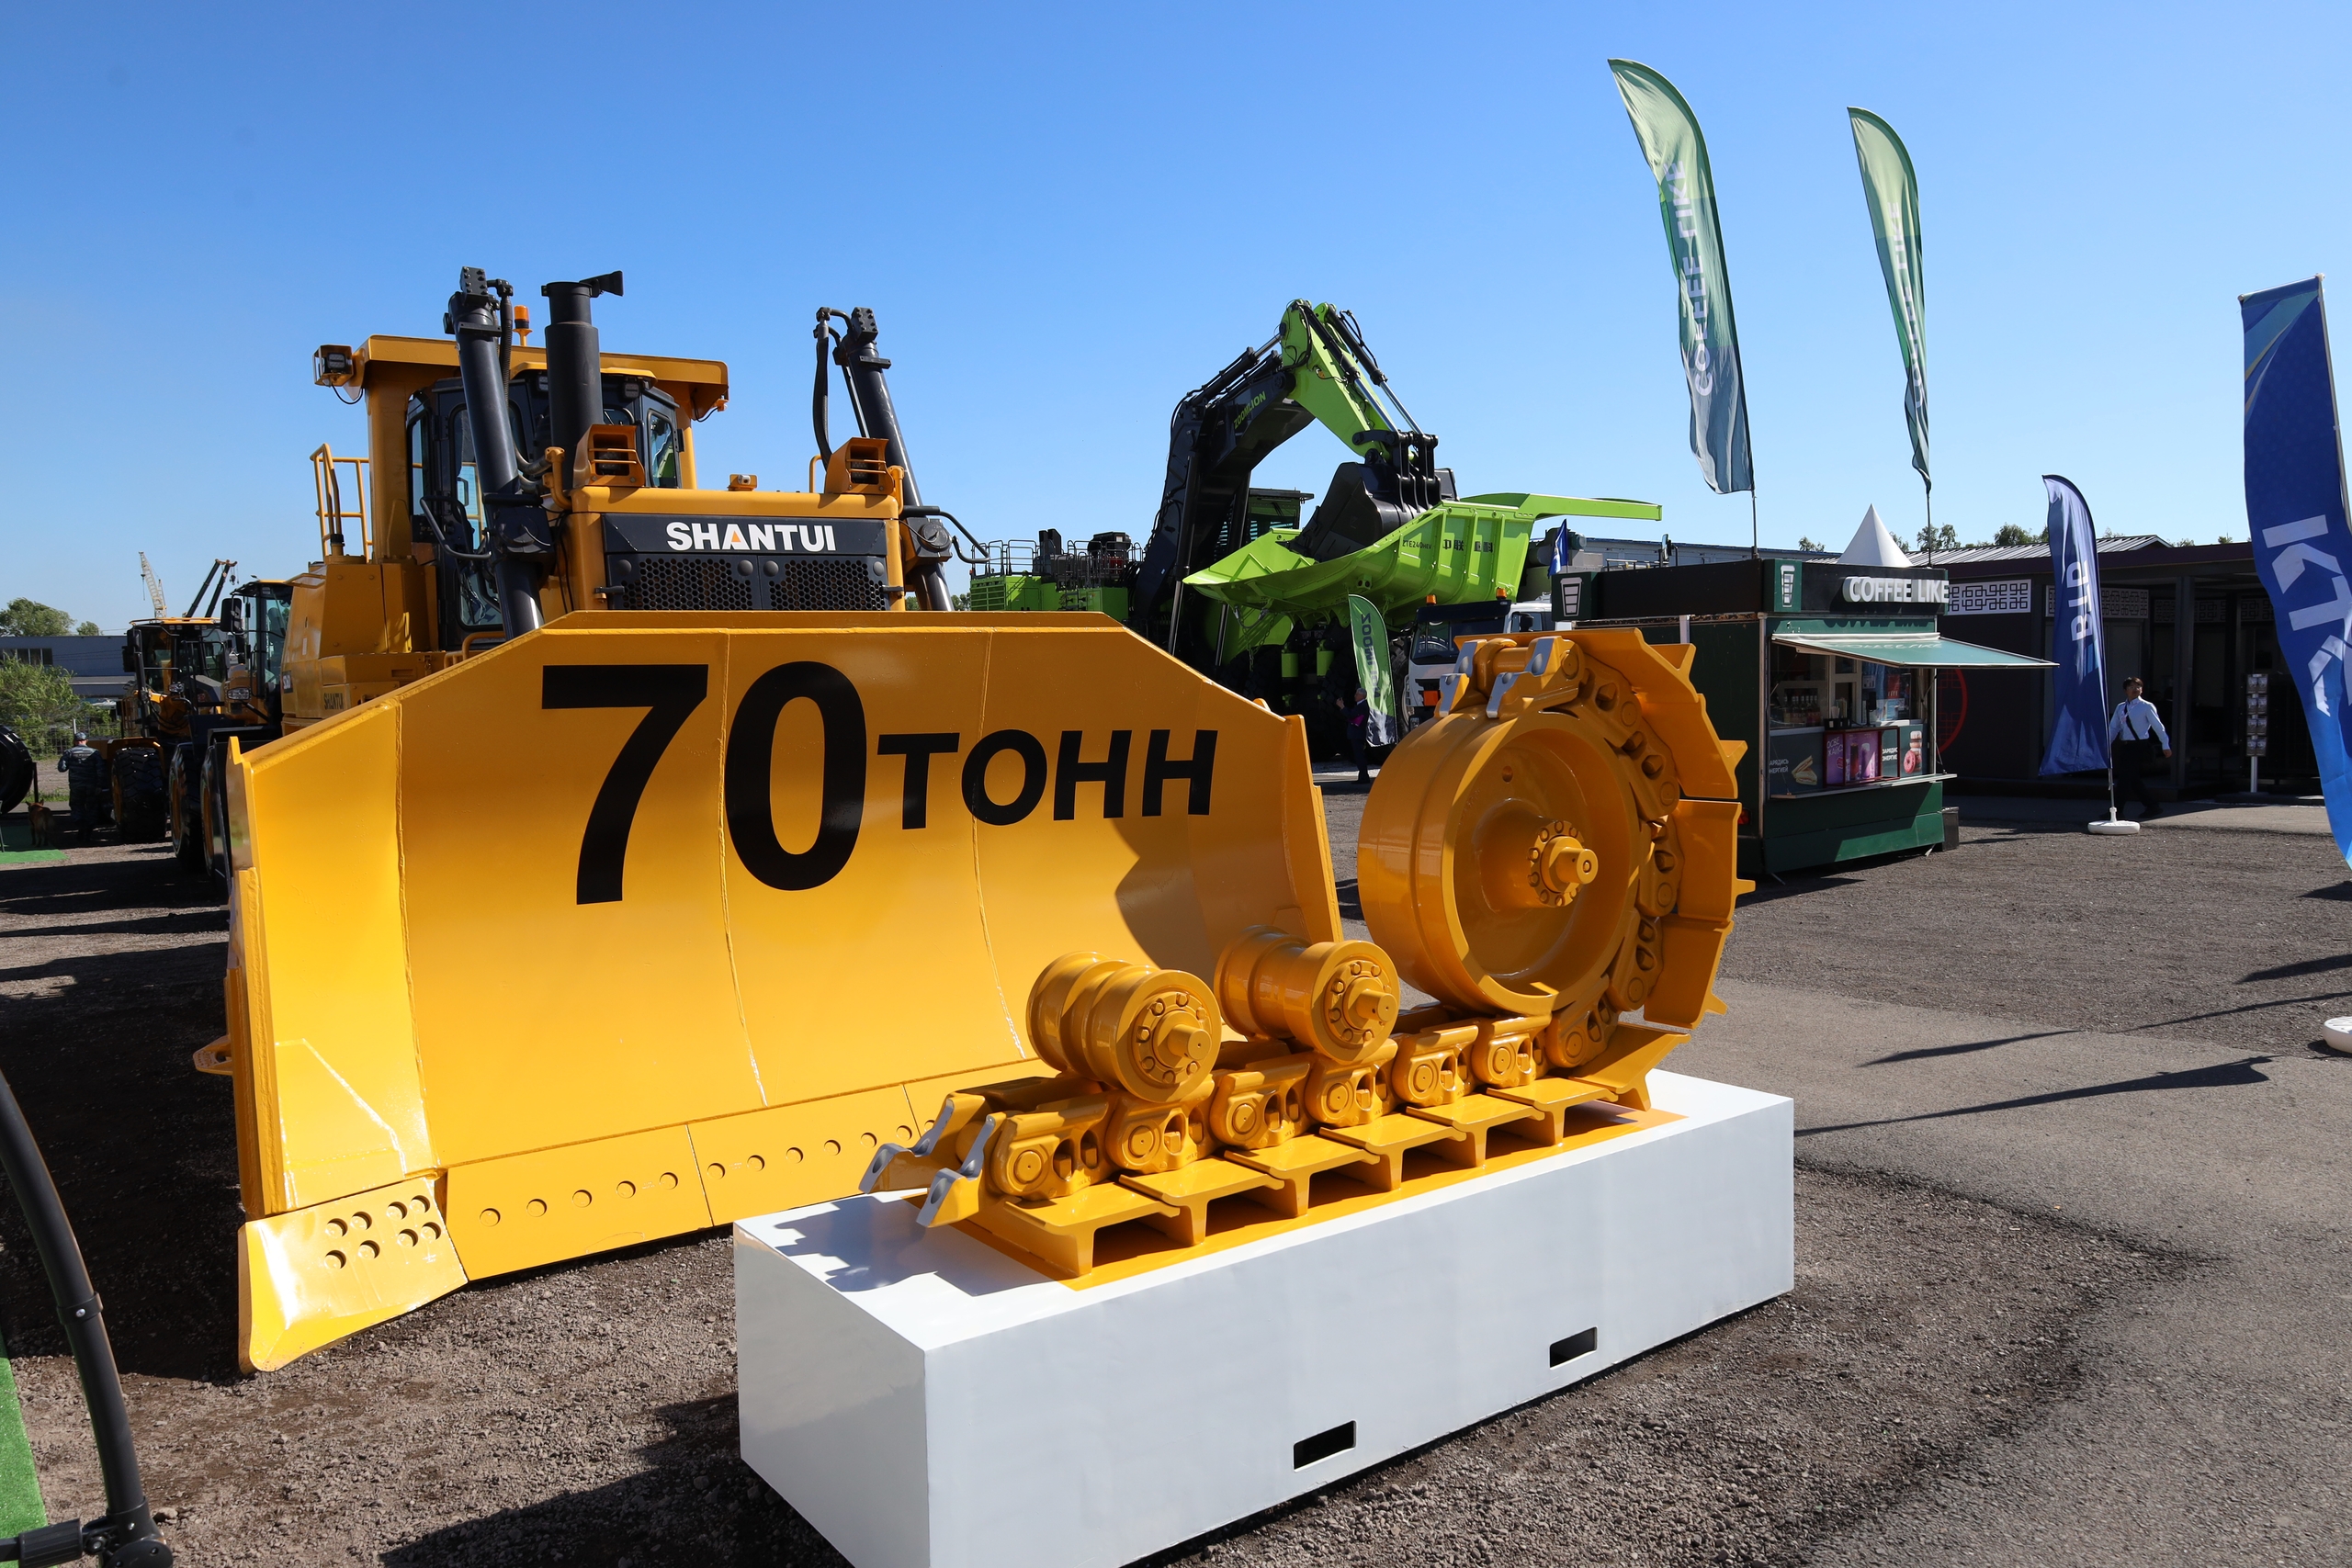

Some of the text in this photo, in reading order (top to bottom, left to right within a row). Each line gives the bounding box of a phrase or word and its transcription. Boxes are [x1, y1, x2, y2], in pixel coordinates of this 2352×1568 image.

[1234, 390, 1267, 430] ZOOMLION
[666, 521, 836, 552] SHANTUI
[1847, 576, 1950, 604] COFFEE LIKE
[323, 693, 345, 710] SHANTUI
[541, 660, 1218, 905] 70 ТОНН
